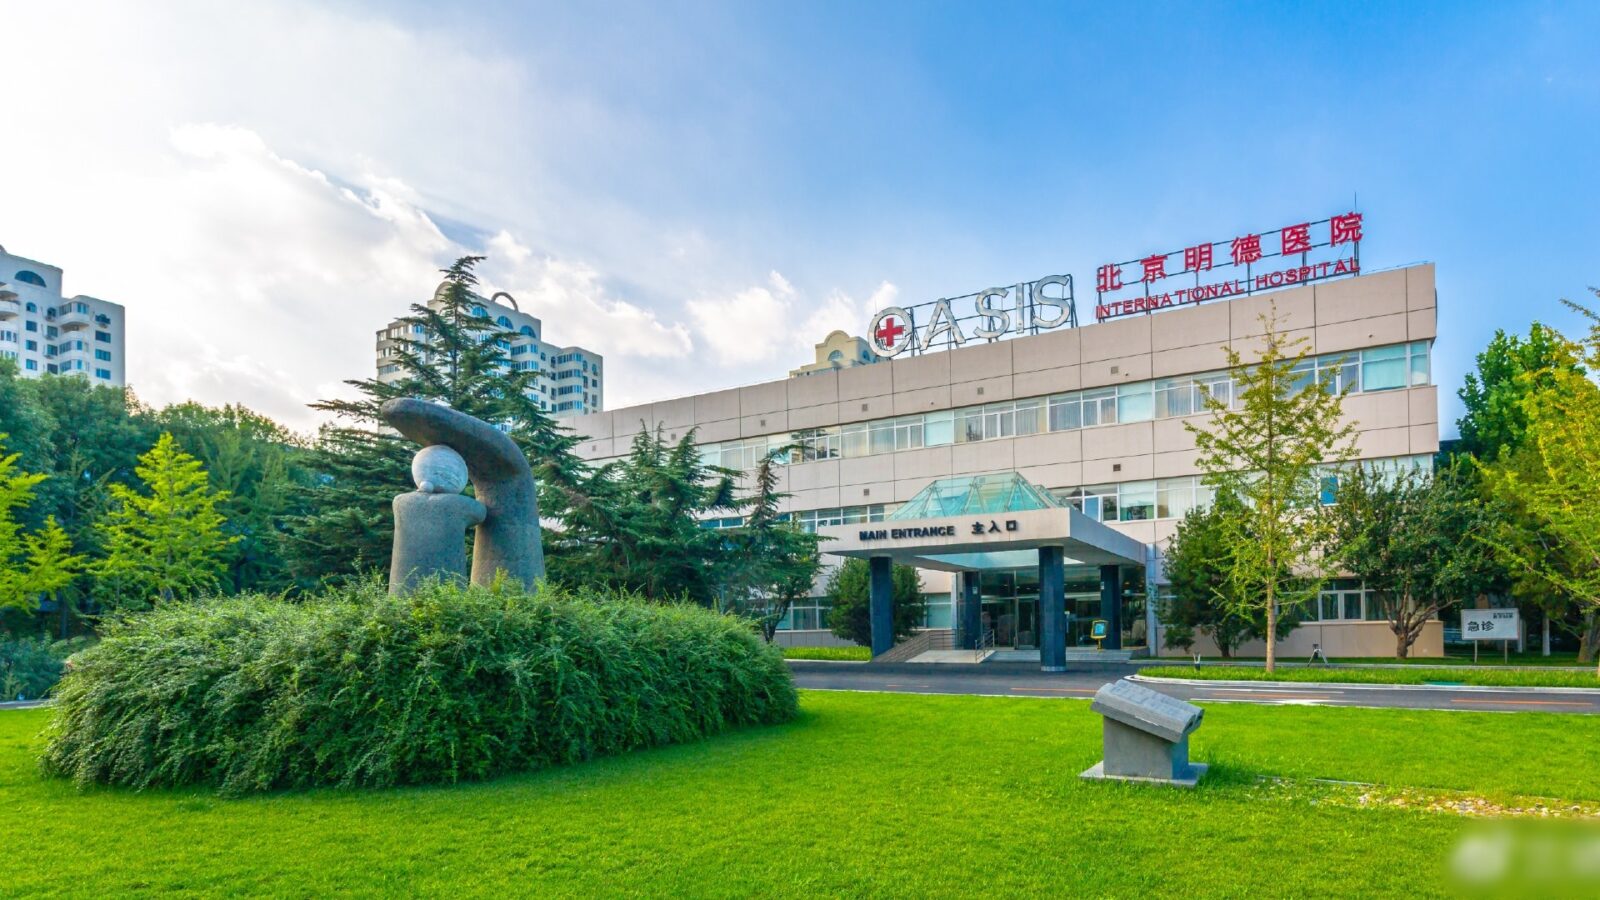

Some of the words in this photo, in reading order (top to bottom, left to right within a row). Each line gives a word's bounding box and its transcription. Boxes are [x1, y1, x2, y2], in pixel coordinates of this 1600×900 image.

[1096, 211, 1363, 293] 北京明德医院
[1095, 279, 1245, 319] INTERNATIONAL
[1255, 256, 1361, 290] HOSPITAL
[867, 275, 1070, 358] OASIS
[859, 529, 887, 541] MAIN
[891, 525, 955, 539] ENTRANCE
[971, 520, 1018, 535] 主入口
[1467, 620, 1495, 632] 急诊
